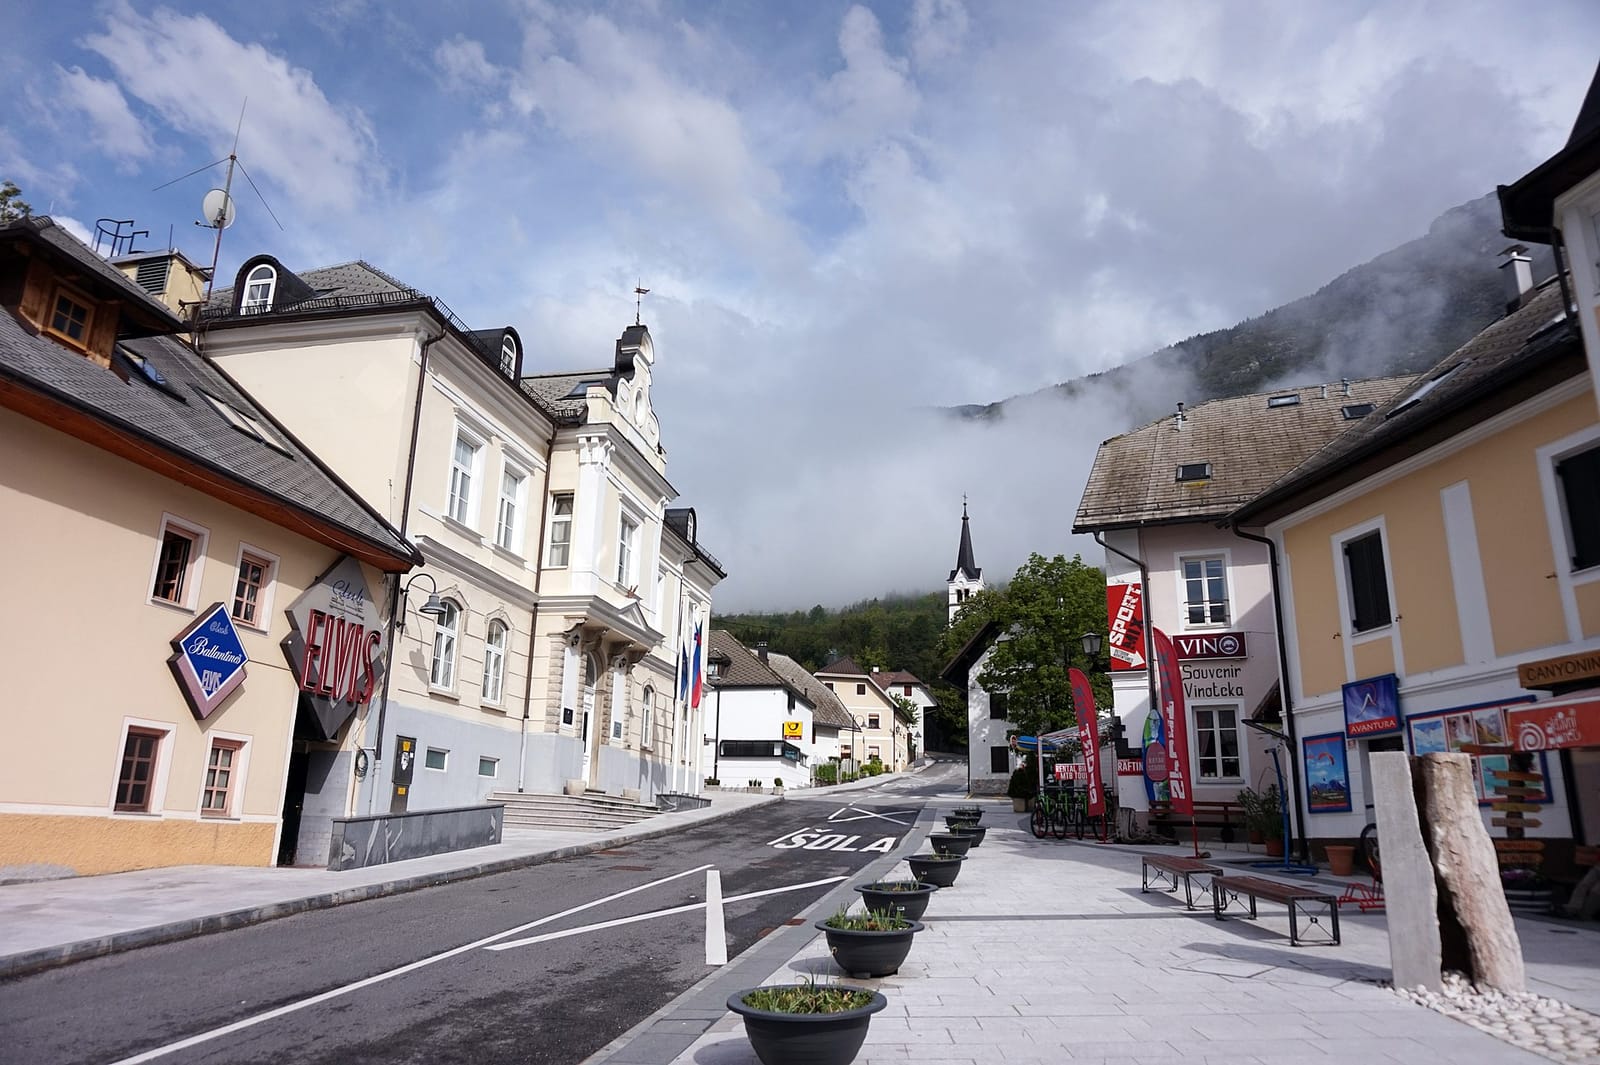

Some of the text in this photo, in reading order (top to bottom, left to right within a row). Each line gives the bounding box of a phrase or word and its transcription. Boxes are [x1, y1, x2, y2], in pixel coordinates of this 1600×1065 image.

[1109, 584, 1141, 646] SPORT
[1121, 616, 1144, 650] MIX
[300, 608, 381, 704] ELVIS
[202, 669, 222, 692] ELVIS
[1182, 664, 1241, 680] Souvenir
[1184, 681, 1244, 698] Vinoteka
[1350, 719, 1396, 734] AVANTURA
[1075, 771, 1088, 779] TOU
[773, 828, 896, 852] ŠOLA
